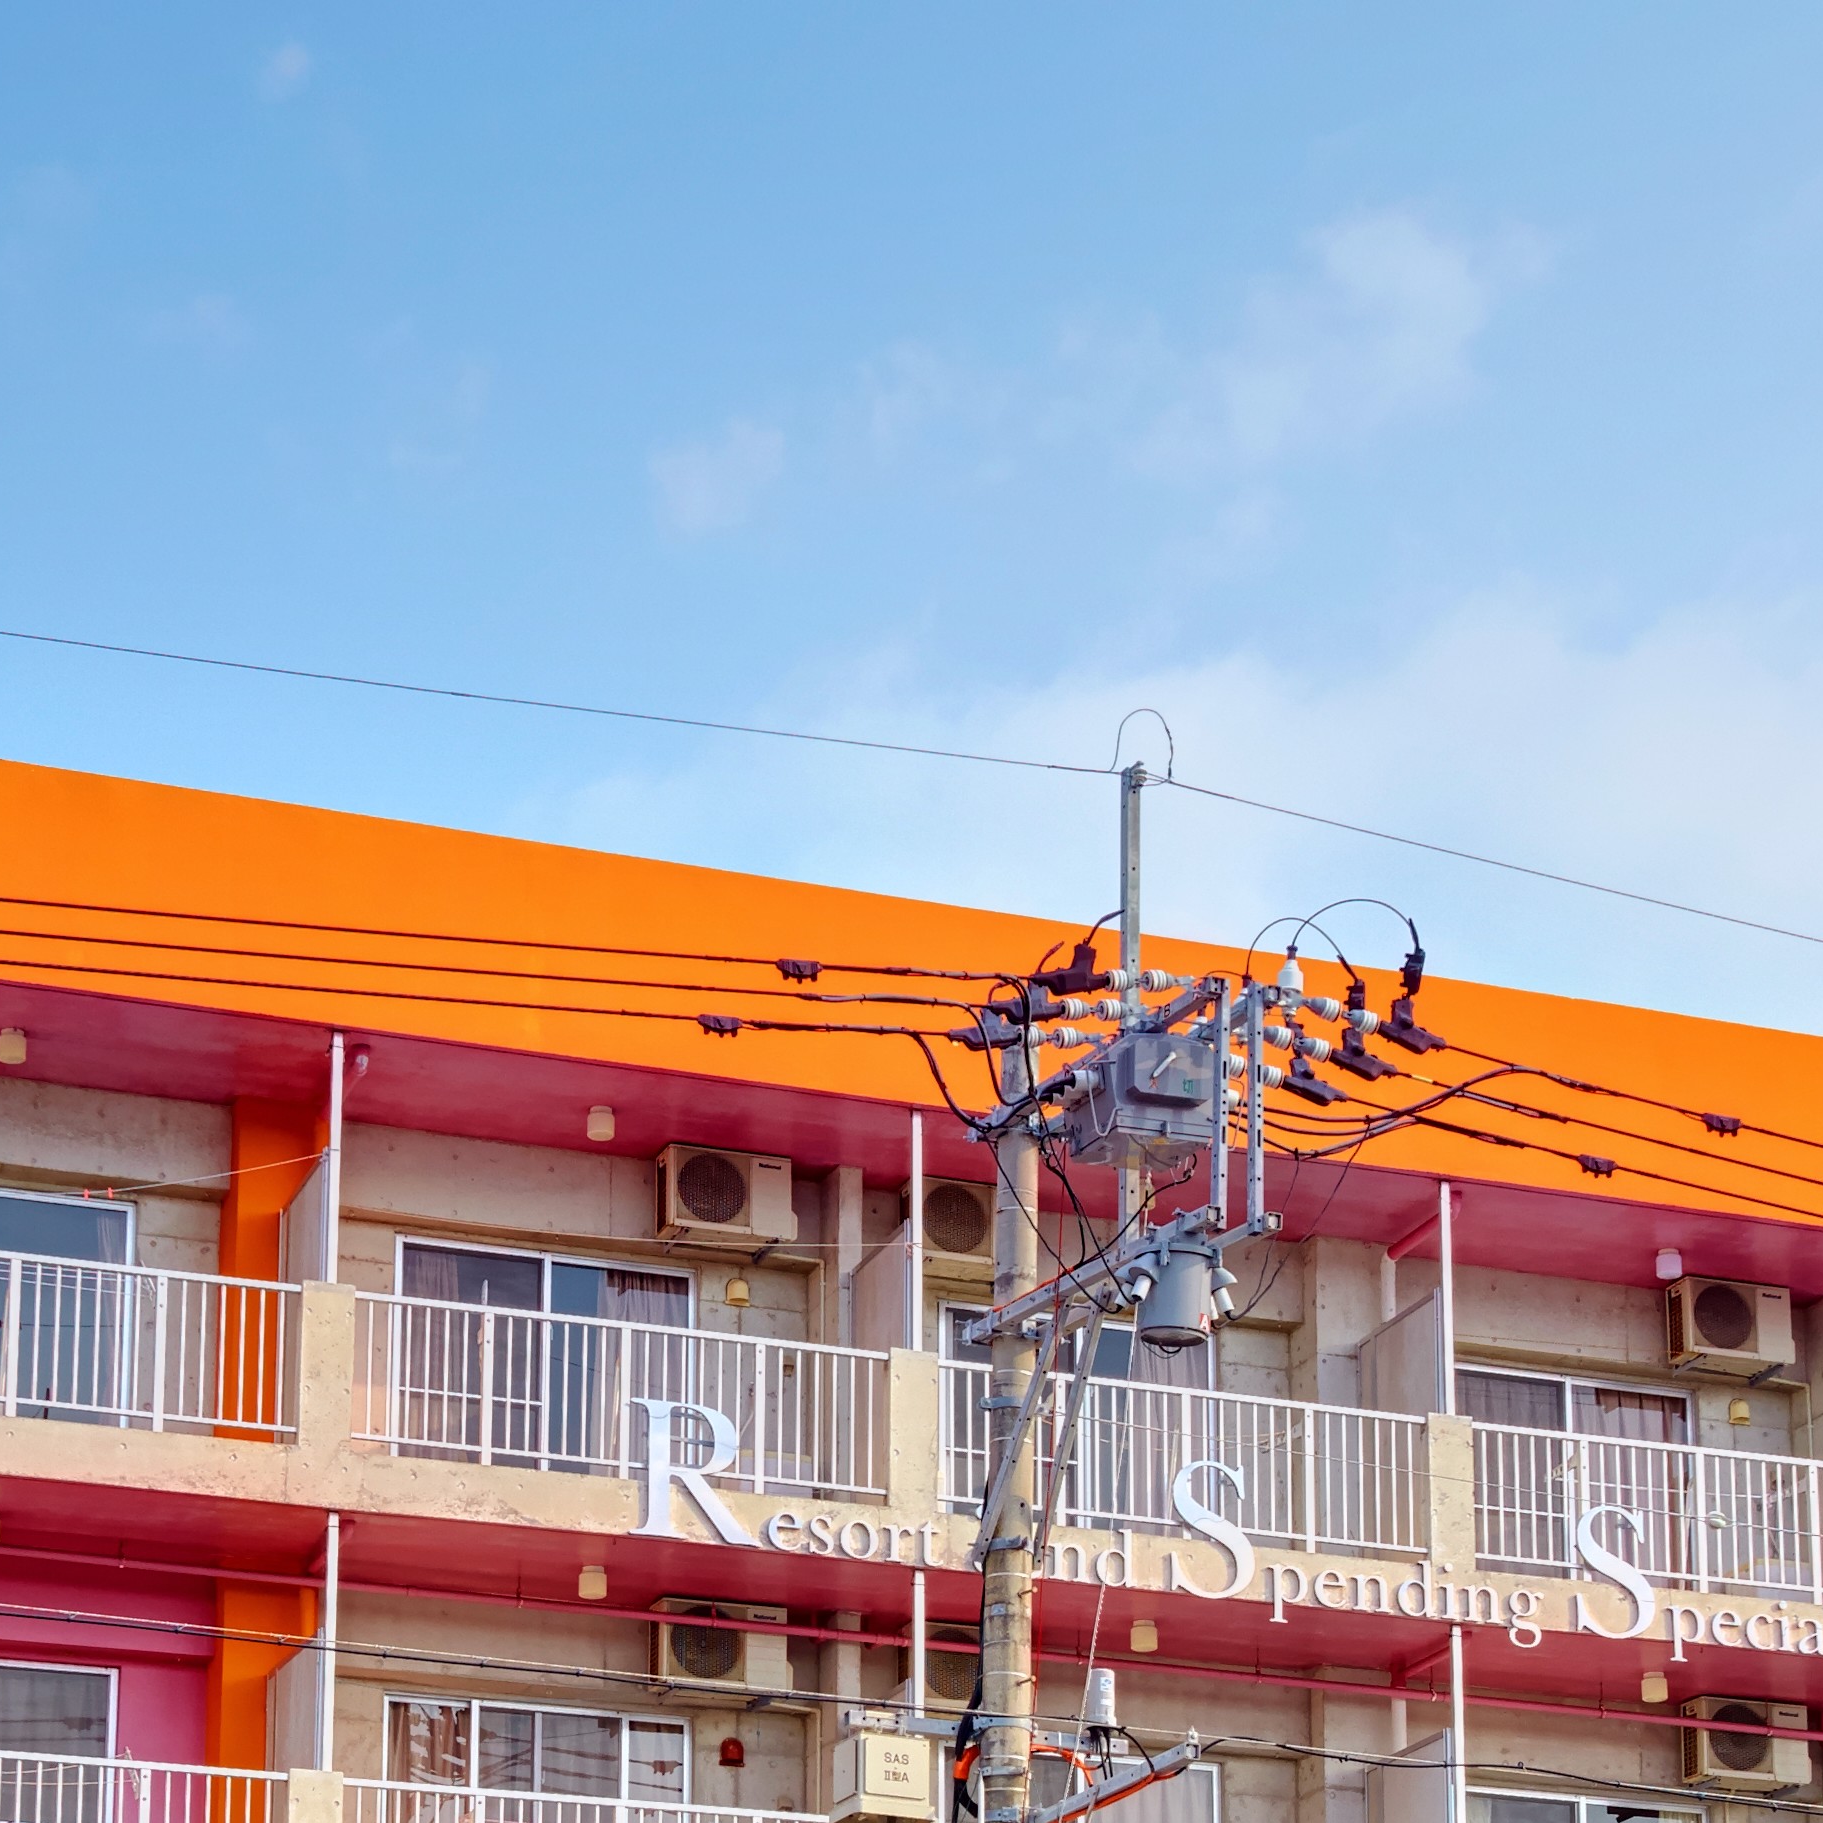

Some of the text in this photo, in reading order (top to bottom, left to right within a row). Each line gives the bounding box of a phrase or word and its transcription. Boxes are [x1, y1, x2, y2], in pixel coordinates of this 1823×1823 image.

[1182, 1078, 1194, 1094] 切
[1199, 1313, 1210, 1334] A
[627, 1396, 943, 1568] Resort
[974, 1503, 1138, 1589] nd
[1170, 1459, 1545, 1649] Spending
[753, 1613, 777, 1621] National
